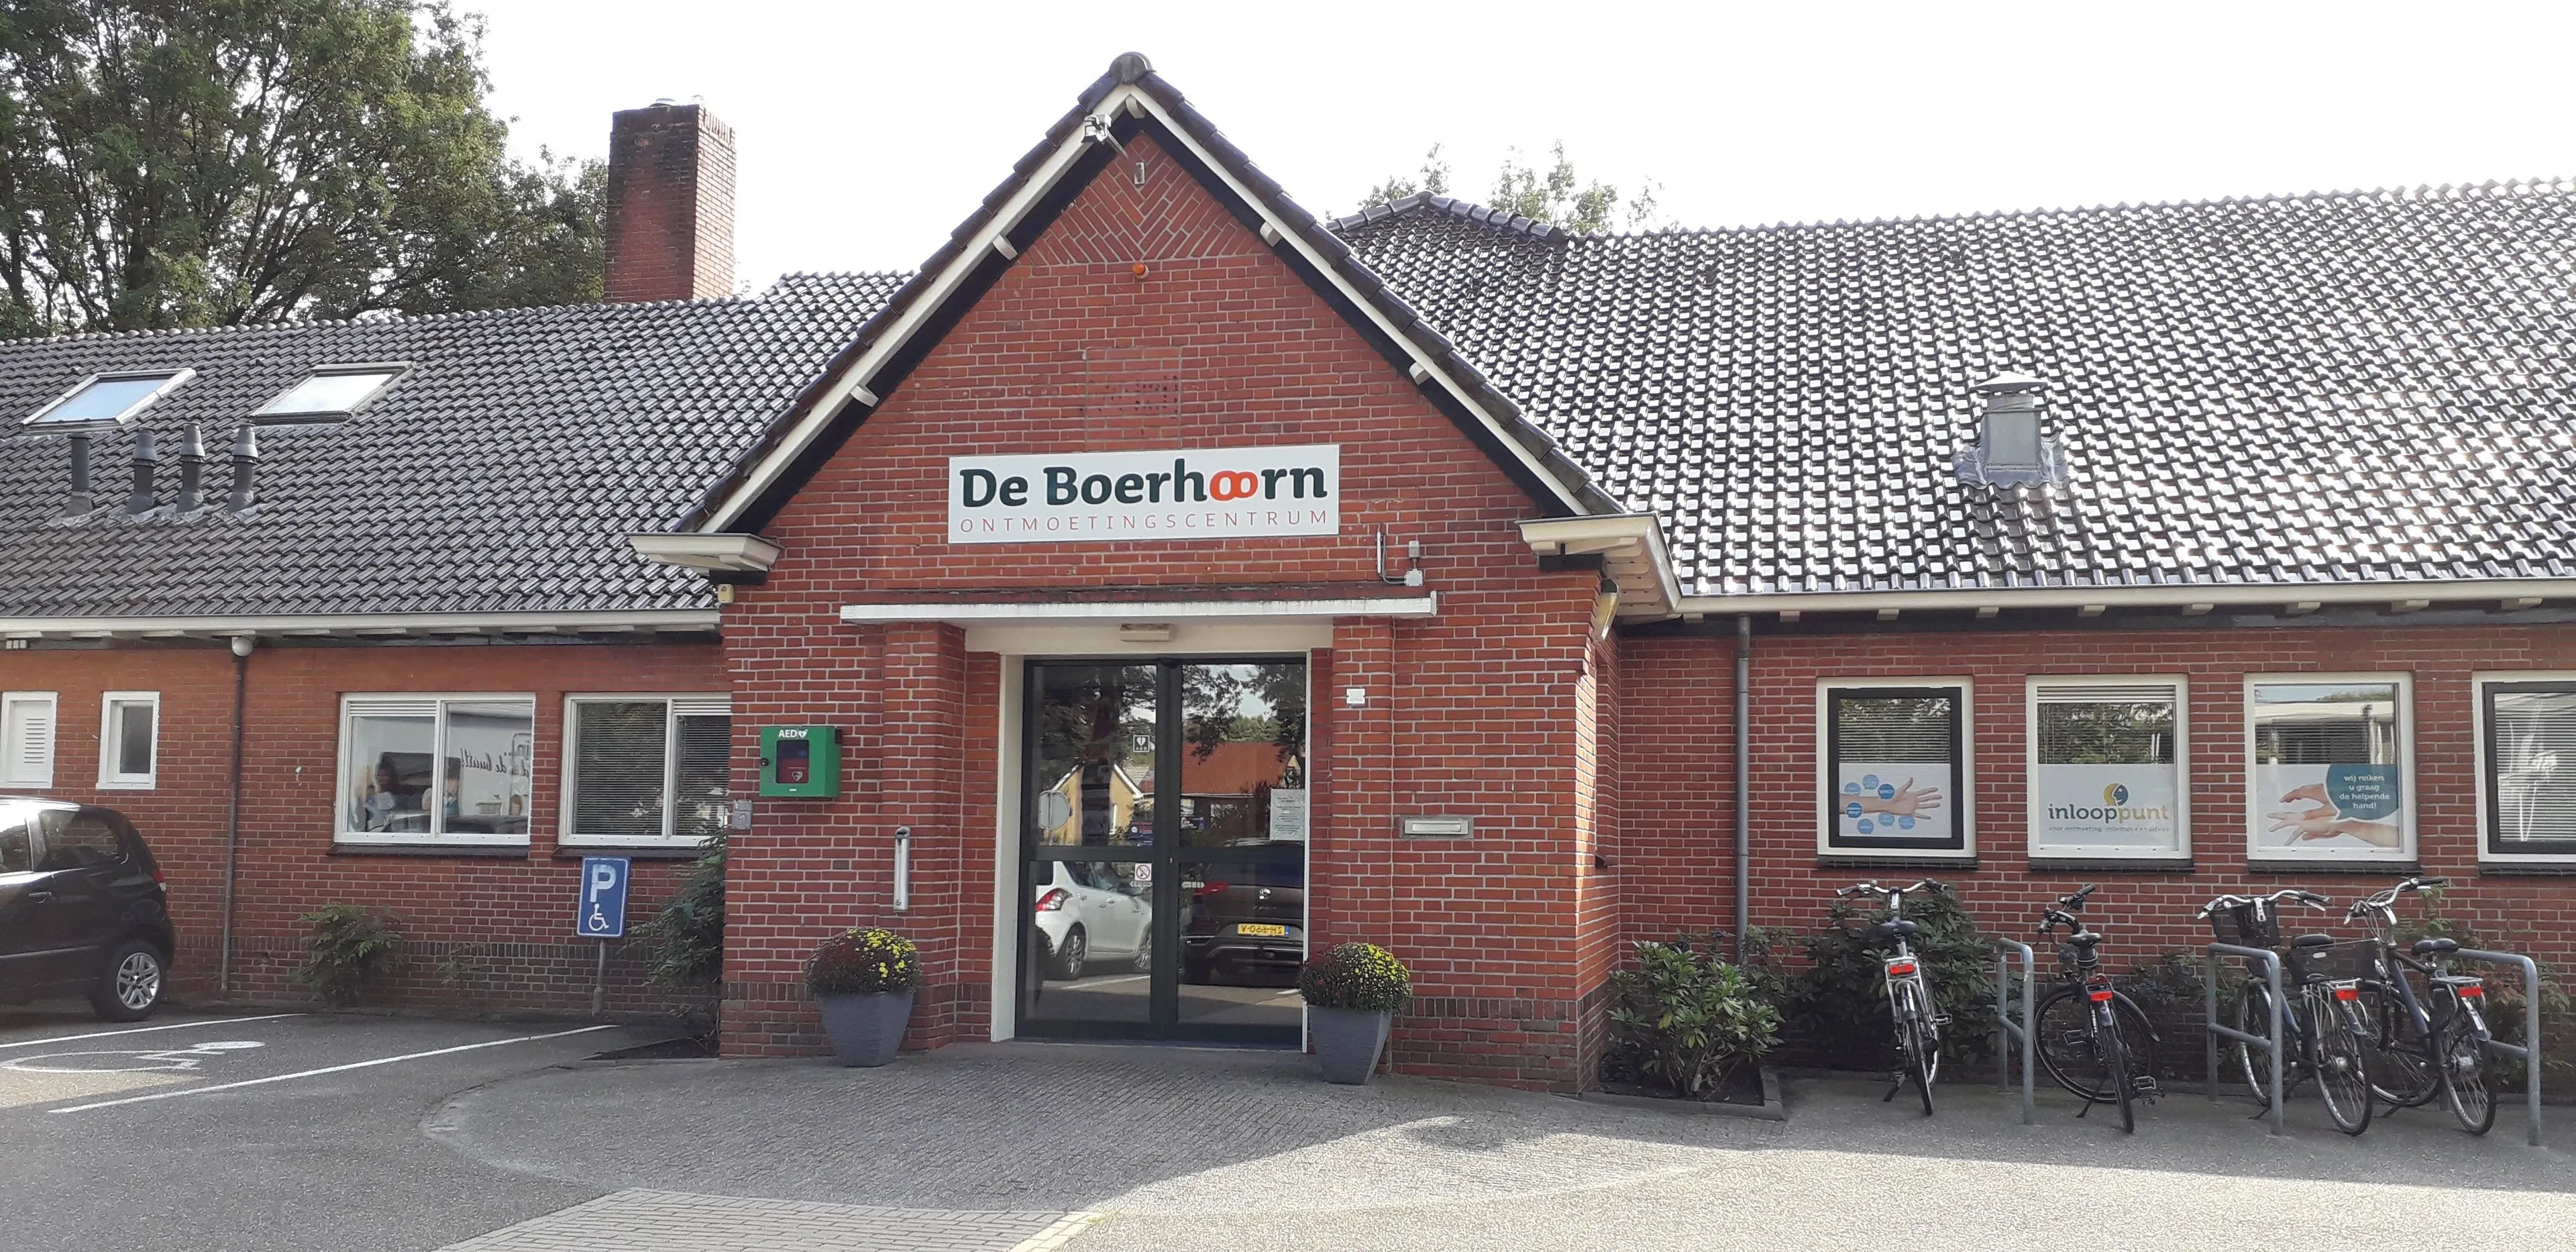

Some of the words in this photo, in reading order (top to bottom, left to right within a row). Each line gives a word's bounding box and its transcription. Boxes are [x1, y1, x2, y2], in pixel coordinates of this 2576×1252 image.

[959, 468, 1028, 508] De
[1042, 458, 1328, 506] Boerhoorn
[960, 510, 1327, 533] ONTMOETINGSCENTRUM
[778, 729, 798, 738] AED
[2343, 774, 2357, 782] wij
[2358, 774, 2384, 782] reiken
[2351, 793, 2390, 801] helpende
[2048, 804, 2169, 824] inlooppunt
[590, 864, 617, 902] P
